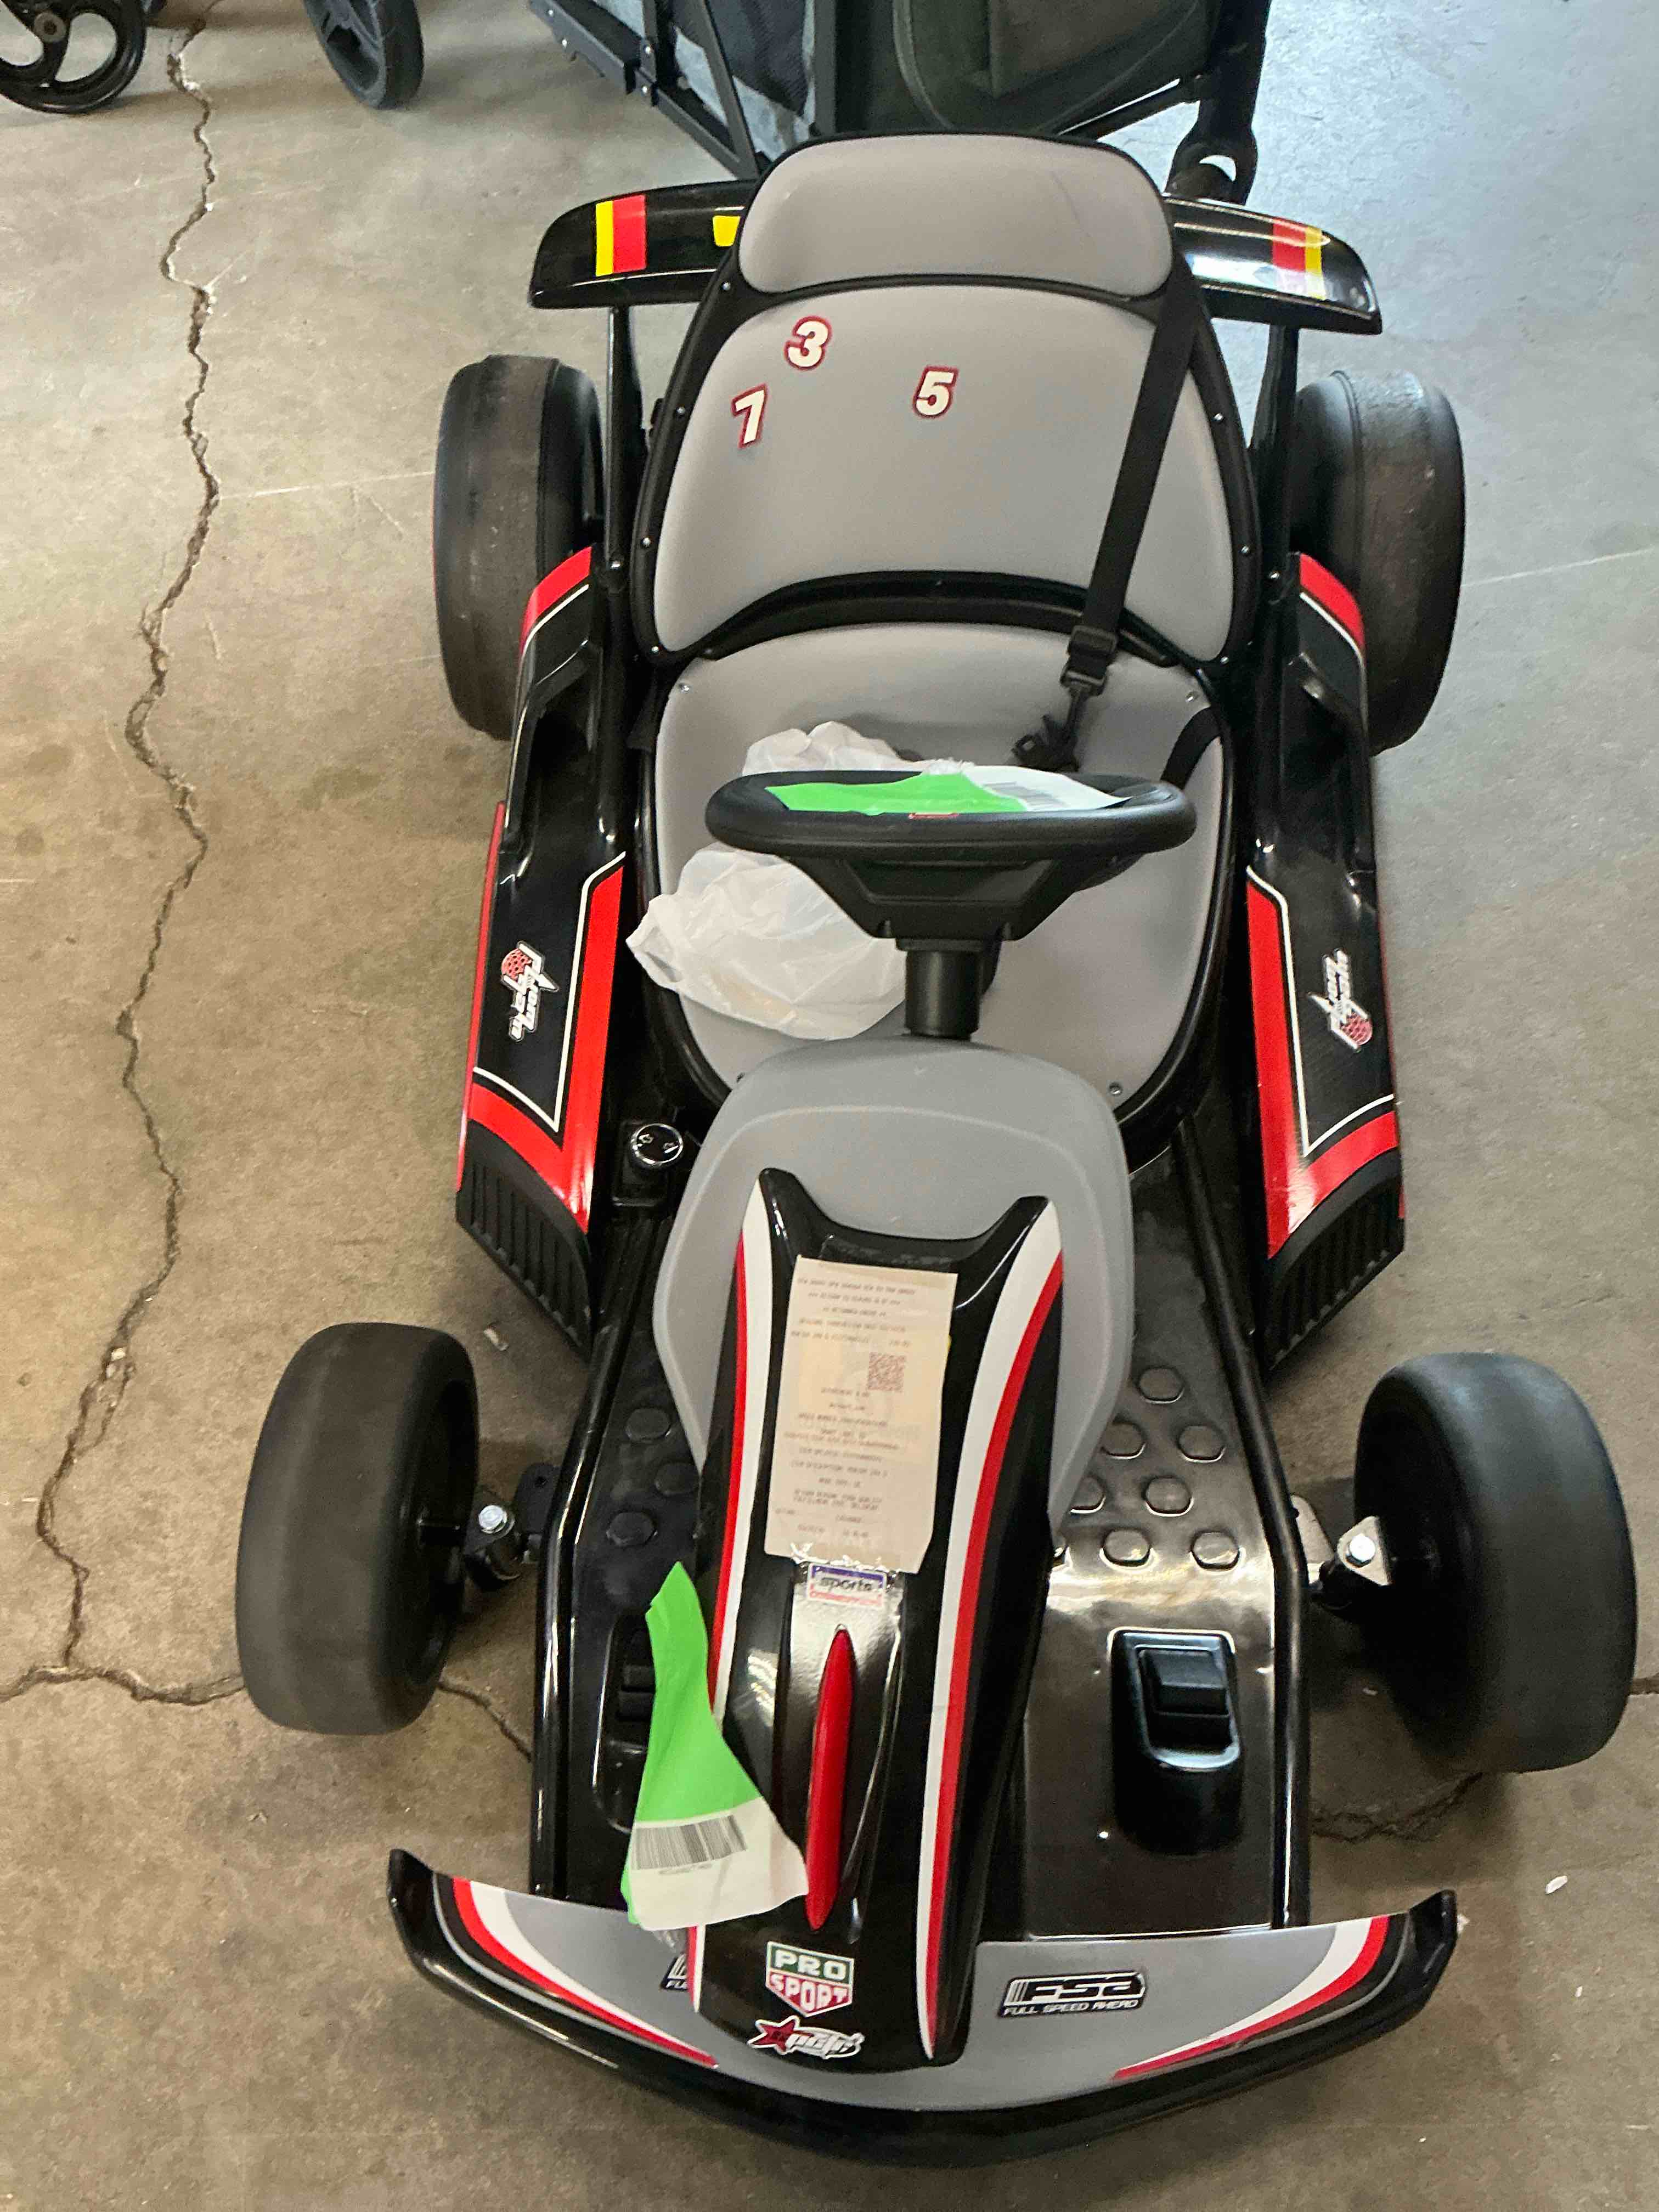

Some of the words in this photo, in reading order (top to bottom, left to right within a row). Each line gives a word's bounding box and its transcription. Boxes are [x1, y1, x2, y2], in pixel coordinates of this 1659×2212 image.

[784, 316, 832, 371] 3
[913, 365, 958, 418] 5
[731, 383, 768, 448] 7
[775, 1949, 847, 1980] PRO
[770, 1974, 848, 2011] SPORT
[1003, 2006, 1037, 2016] FULL
[1043, 2003, 1089, 2013] SPEED
